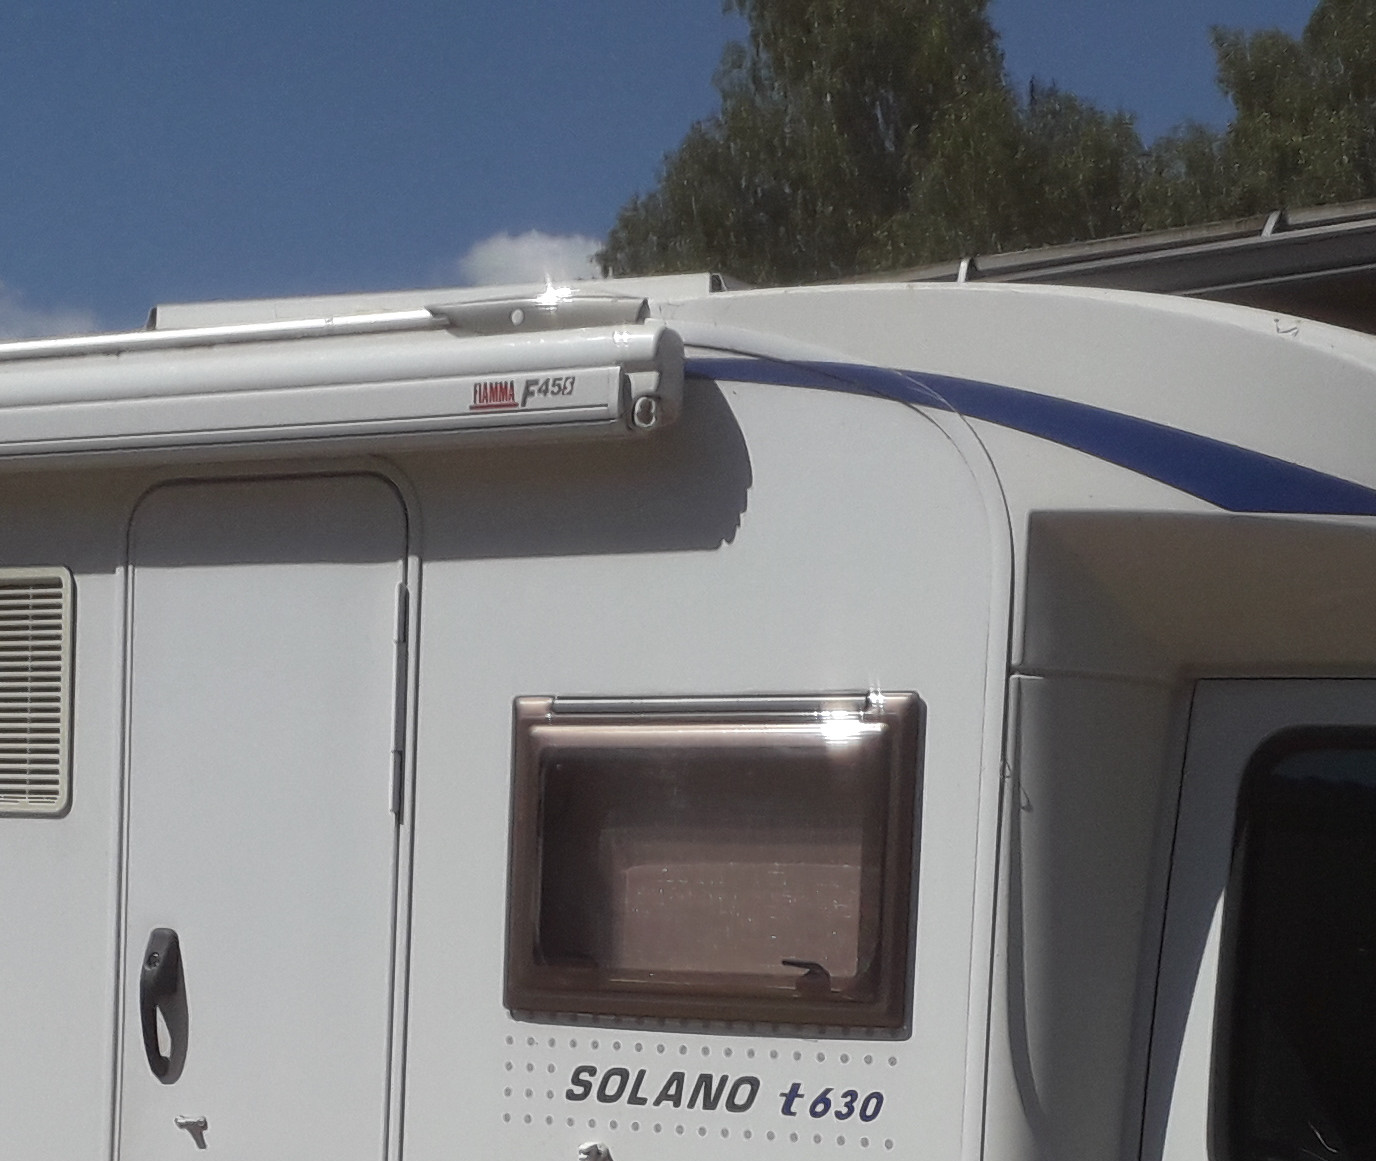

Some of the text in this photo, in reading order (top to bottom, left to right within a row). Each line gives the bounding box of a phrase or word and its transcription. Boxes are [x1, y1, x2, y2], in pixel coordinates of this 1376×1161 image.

[473, 380, 515, 404] FIAMMA
[565, 1065, 884, 1122] SOLANO t630
